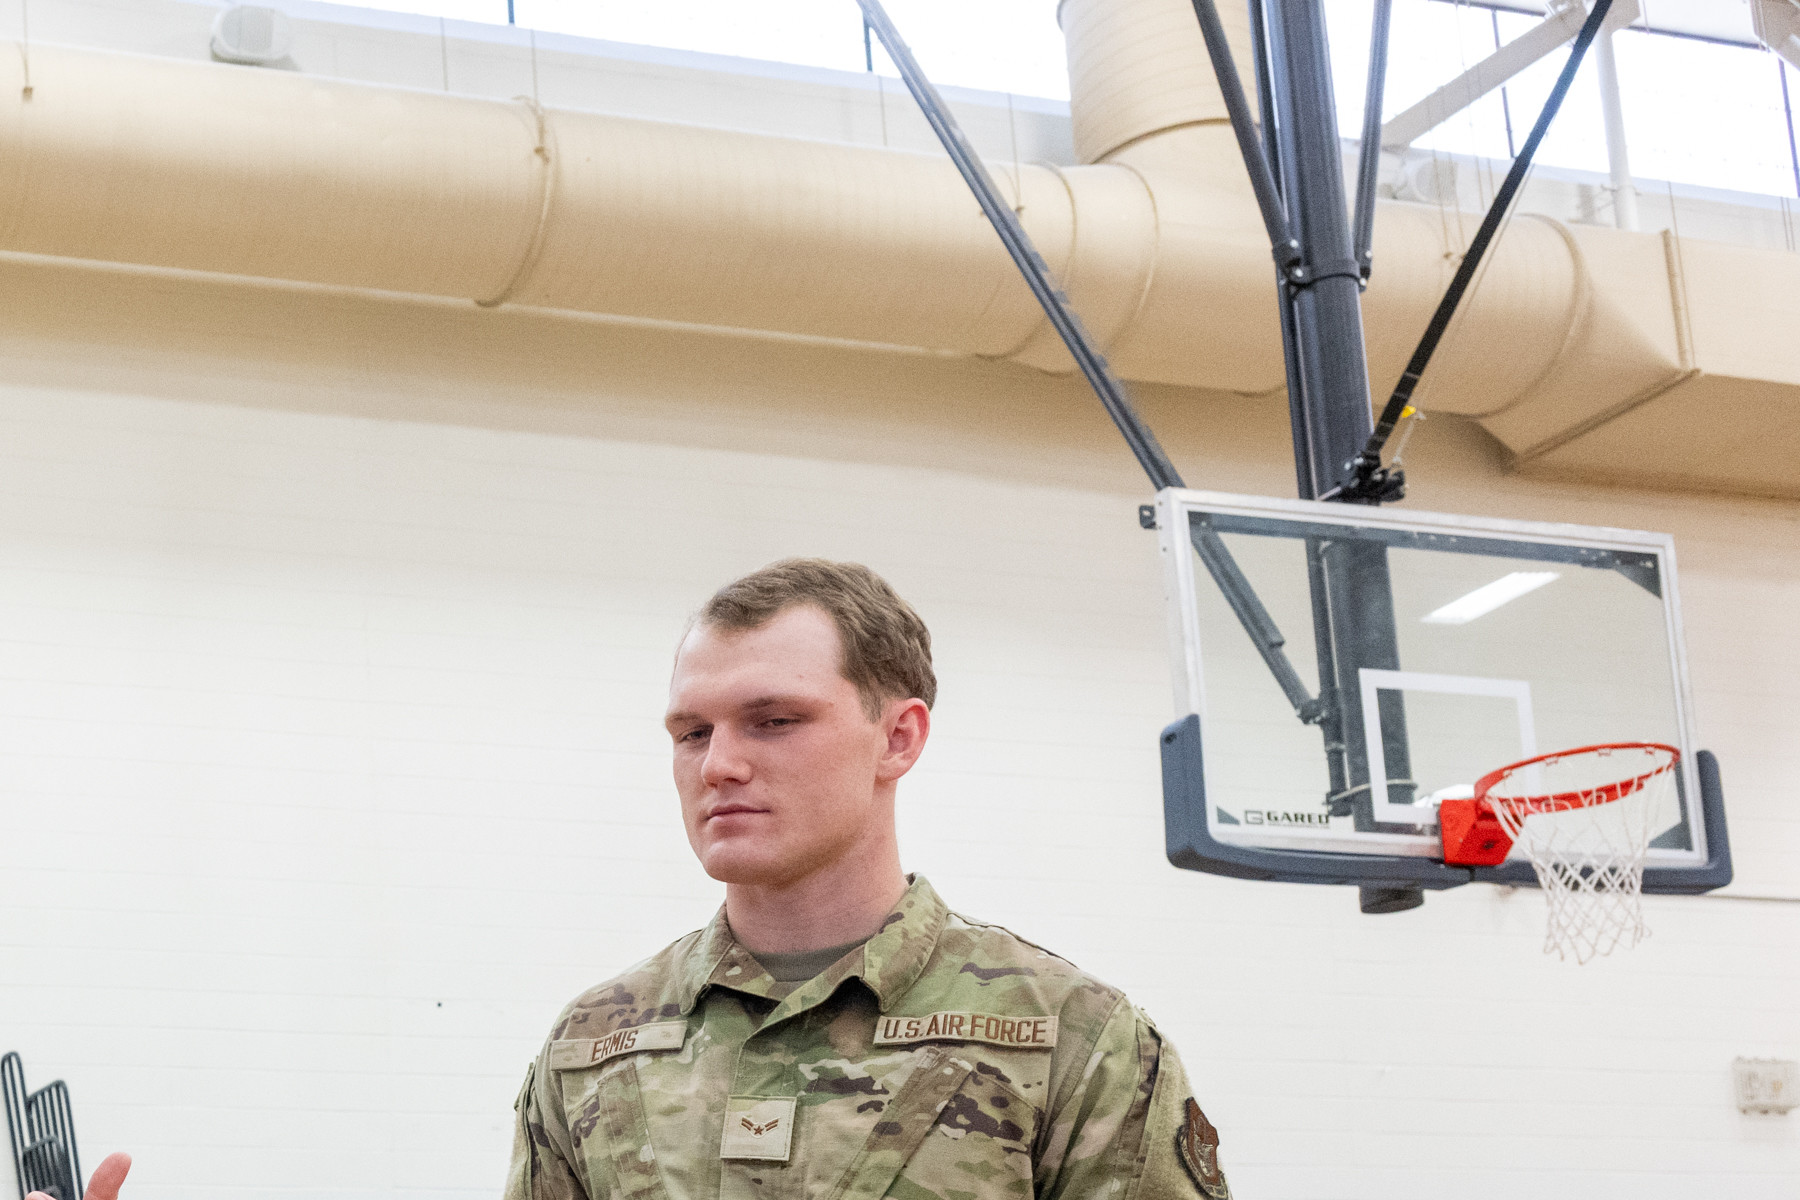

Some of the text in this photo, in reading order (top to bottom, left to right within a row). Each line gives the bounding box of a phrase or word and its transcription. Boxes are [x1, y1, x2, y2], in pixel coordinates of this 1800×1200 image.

[1266, 810, 1329, 824] GARED
[883, 1014, 1048, 1043] U.S. AIR FORCE
[591, 1030, 638, 1062] ERMIS
